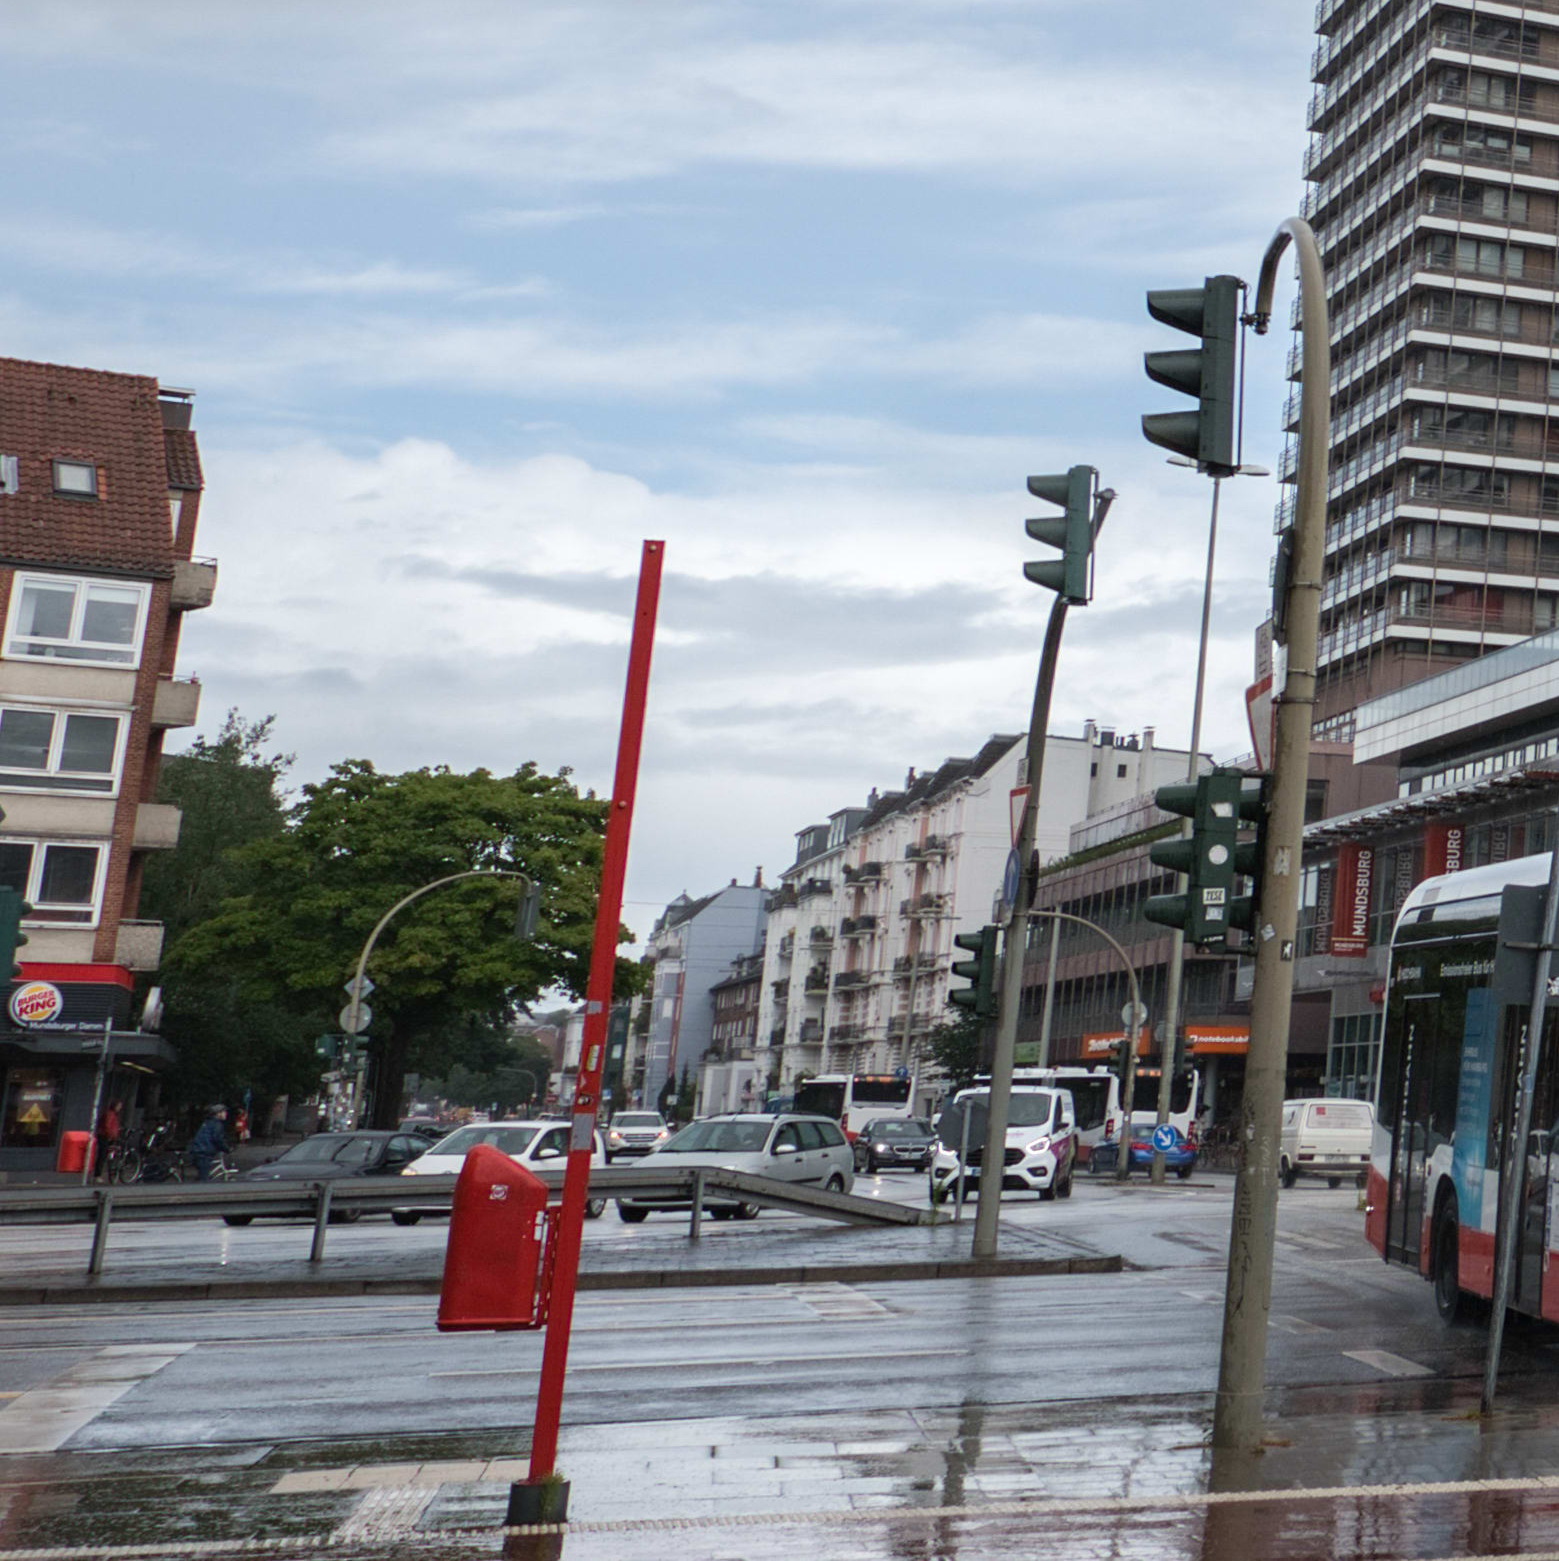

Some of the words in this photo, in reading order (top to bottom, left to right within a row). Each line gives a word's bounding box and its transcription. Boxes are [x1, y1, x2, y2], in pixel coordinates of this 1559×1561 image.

[1352, 850, 1372, 936] MUNDSBURG
[17, 990, 55, 1007] BURGER
[18, 997, 56, 1017] KING
